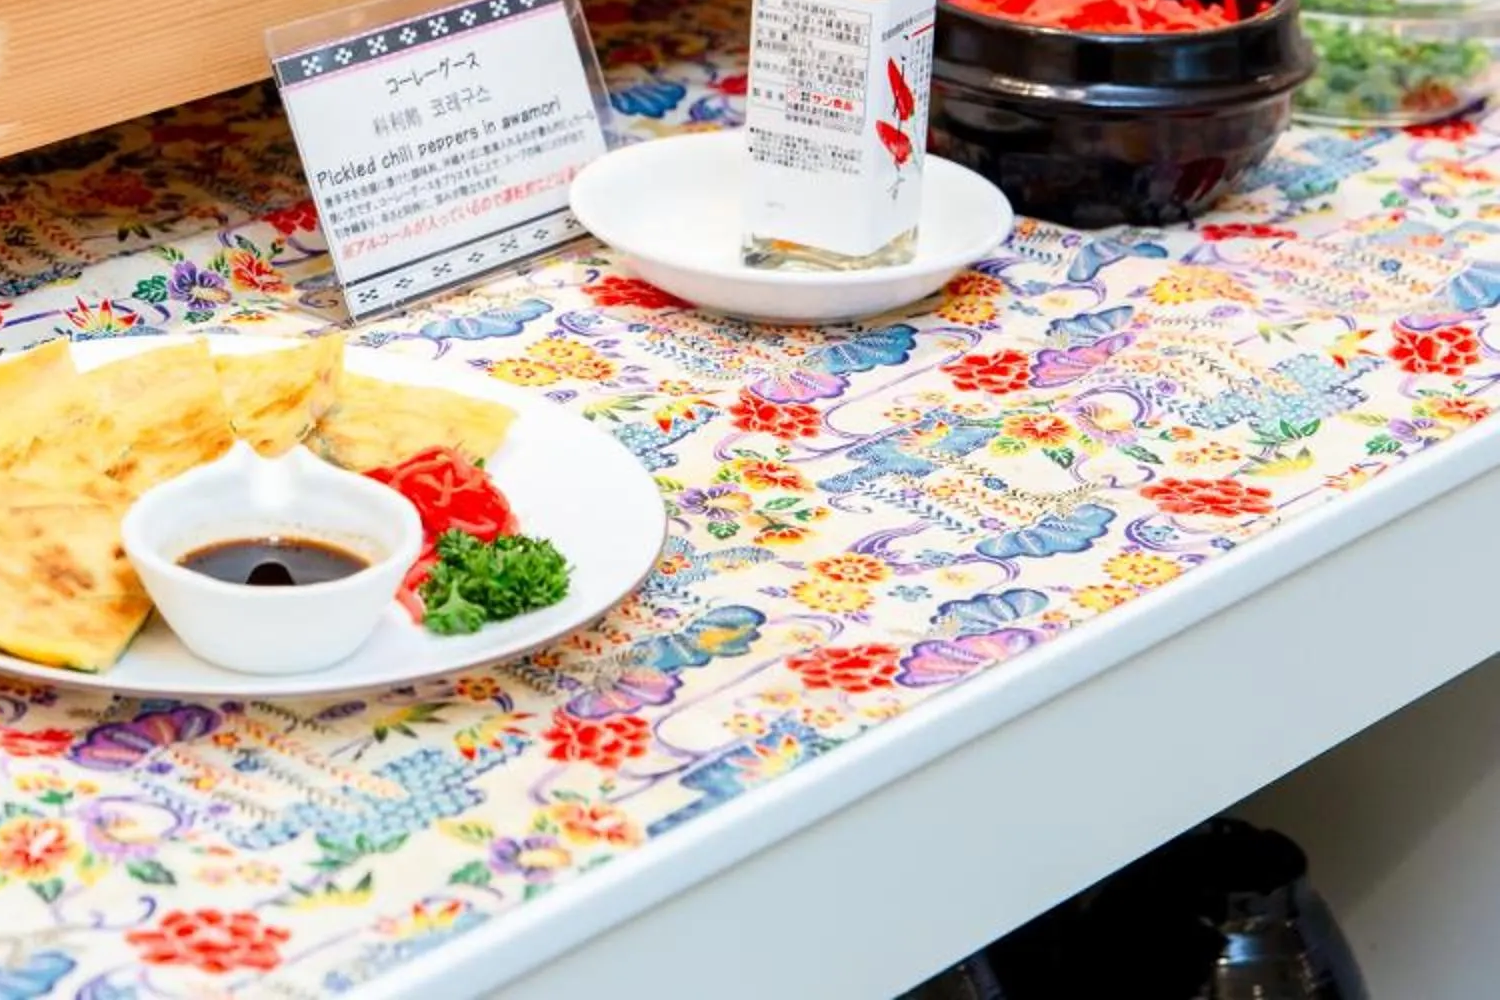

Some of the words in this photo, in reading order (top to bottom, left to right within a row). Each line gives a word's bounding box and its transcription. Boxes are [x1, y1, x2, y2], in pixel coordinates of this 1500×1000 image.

[386, 51, 481, 96] コーレーグース
[316, 155, 377, 189] Pickled
[418, 125, 479, 160] peppers
[481, 120, 497, 136] in
[501, 95, 562, 130] awamori
